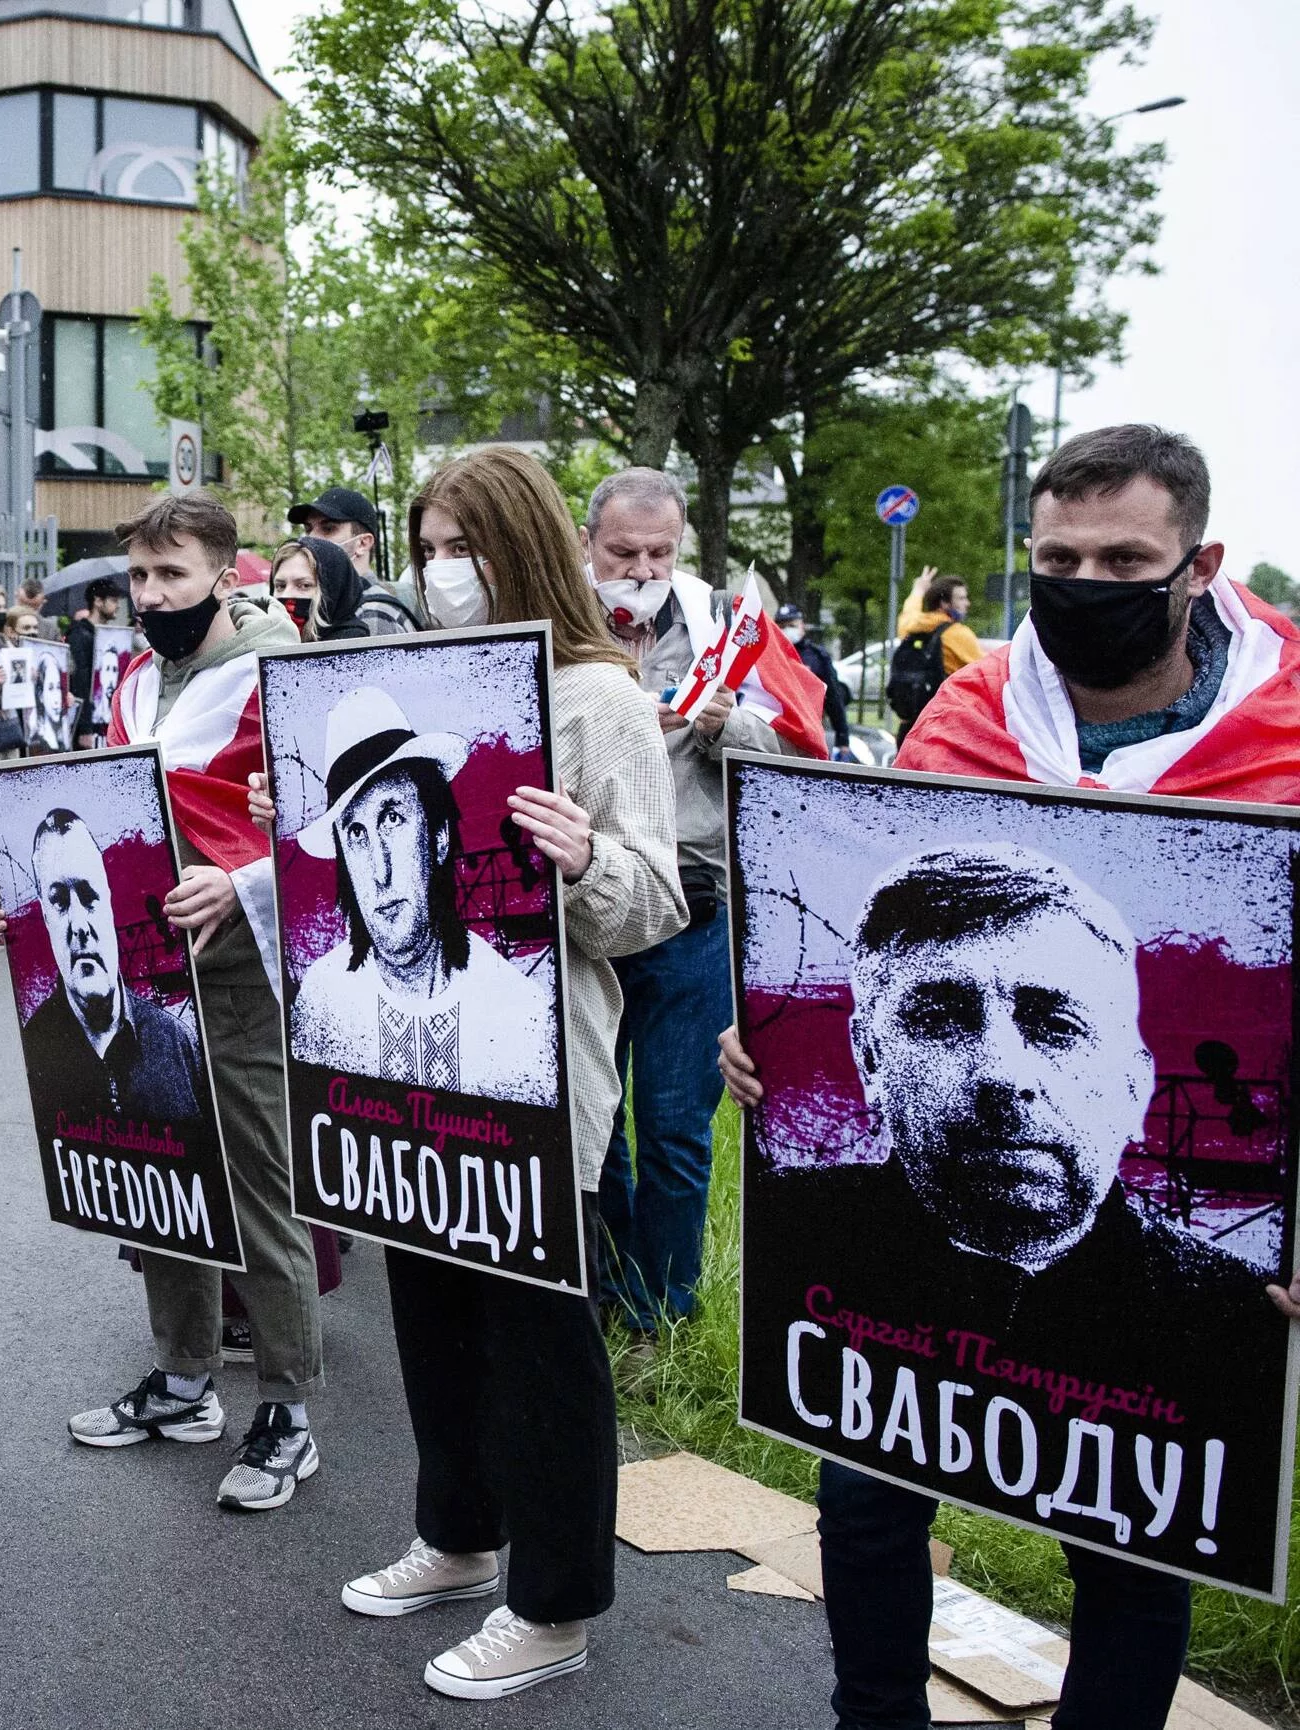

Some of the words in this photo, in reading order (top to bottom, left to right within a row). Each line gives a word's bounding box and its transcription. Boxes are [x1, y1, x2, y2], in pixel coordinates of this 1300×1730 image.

[328, 1077, 404, 1125] Алесь
[407, 1091, 515, 1152] Пушкін
[53, 1139, 214, 1249] FREEDOM
[805, 1284, 940, 1359] Сяргей
[946, 1329, 1185, 1424] Пятрухін
